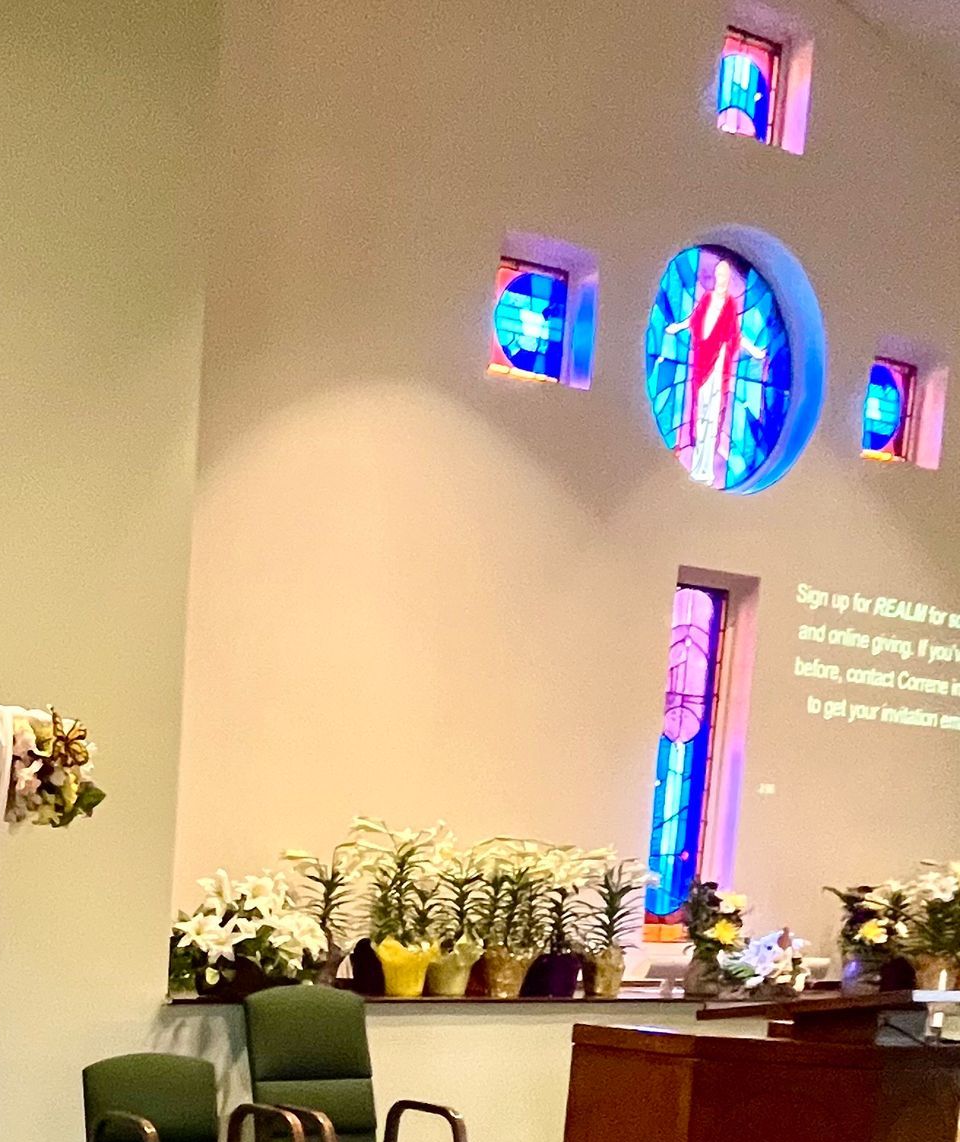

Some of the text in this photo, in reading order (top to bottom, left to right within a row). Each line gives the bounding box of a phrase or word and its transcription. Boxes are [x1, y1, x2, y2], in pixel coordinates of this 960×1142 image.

[796, 583, 829, 609] Sign
[831, 593, 850, 614] up
[852, 592, 872, 613] for
[873, 596, 929, 622] REALM
[929, 606, 948, 625] for
[798, 624, 826, 643] and
[828, 628, 870, 649] online
[871, 633, 914, 660] giving.
[917, 639, 929, 657] If
[794, 656, 842, 684] before,
[846, 668, 895, 688] contact
[807, 695, 821, 714] to
[823, 699, 847, 720] get
[848, 704, 881, 723] your
[880, 703, 938, 727] invitation
